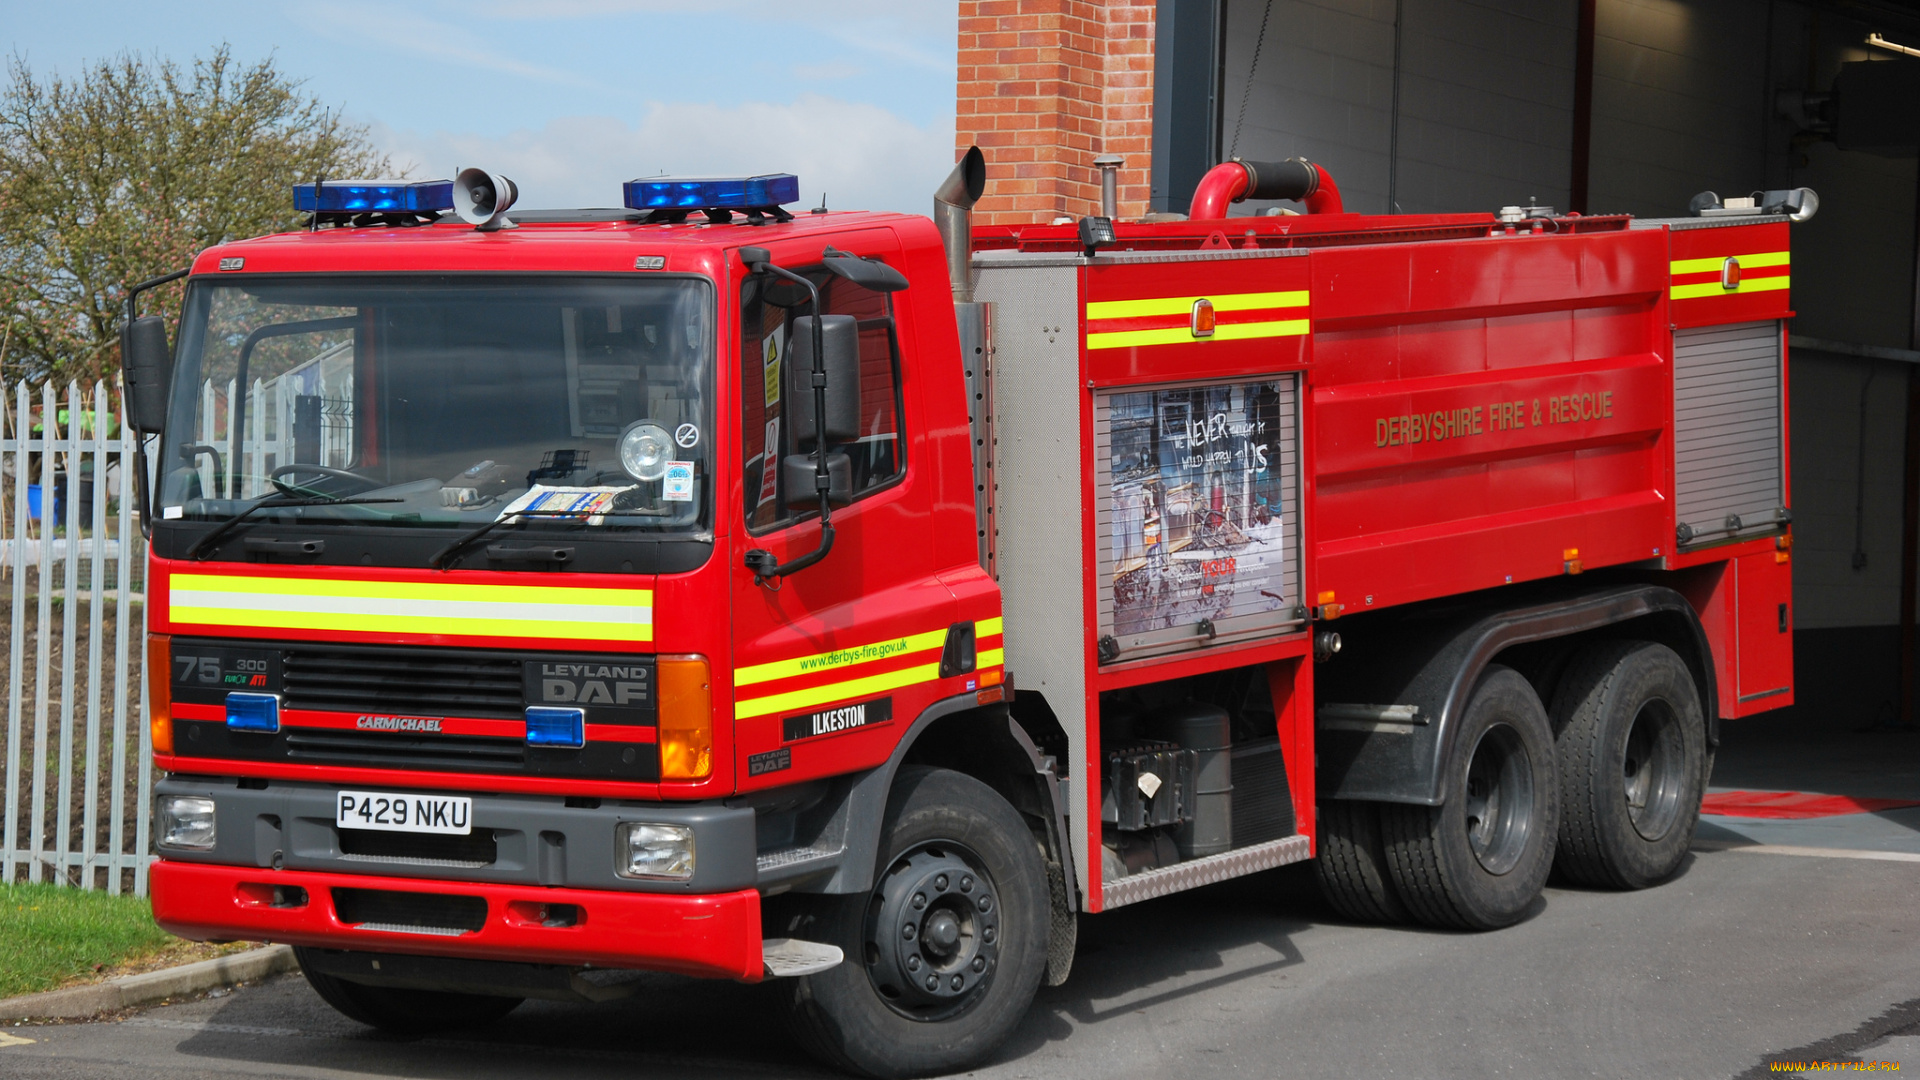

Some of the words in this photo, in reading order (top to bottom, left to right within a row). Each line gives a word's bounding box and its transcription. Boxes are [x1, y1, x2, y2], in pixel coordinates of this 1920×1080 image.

[1185, 413, 1228, 449] NEVER
[1376, 406, 1483, 447] DERBYSHIRE
[1489, 401, 1525, 432] FIRE
[1531, 398, 1543, 426] &
[1549, 391, 1613, 424] RESCUE
[1244, 440, 1268, 474] US
[1202, 557, 1236, 578] YOUR
[800, 638, 908, 669] www.derbys-fire.gov.uk
[175, 656, 220, 683] 75
[236, 659, 267, 671] 300
[542, 664, 647, 679] LEYLAND
[543, 679, 647, 704] DAF
[356, 715, 442, 732] CARMICHAEL
[813, 705, 865, 735] ILKESTON
[751, 750, 789, 762] LEYLAND
[751, 757, 789, 774] DAF
[341, 796, 407, 825] P429
[416, 800, 467, 828] NKU
